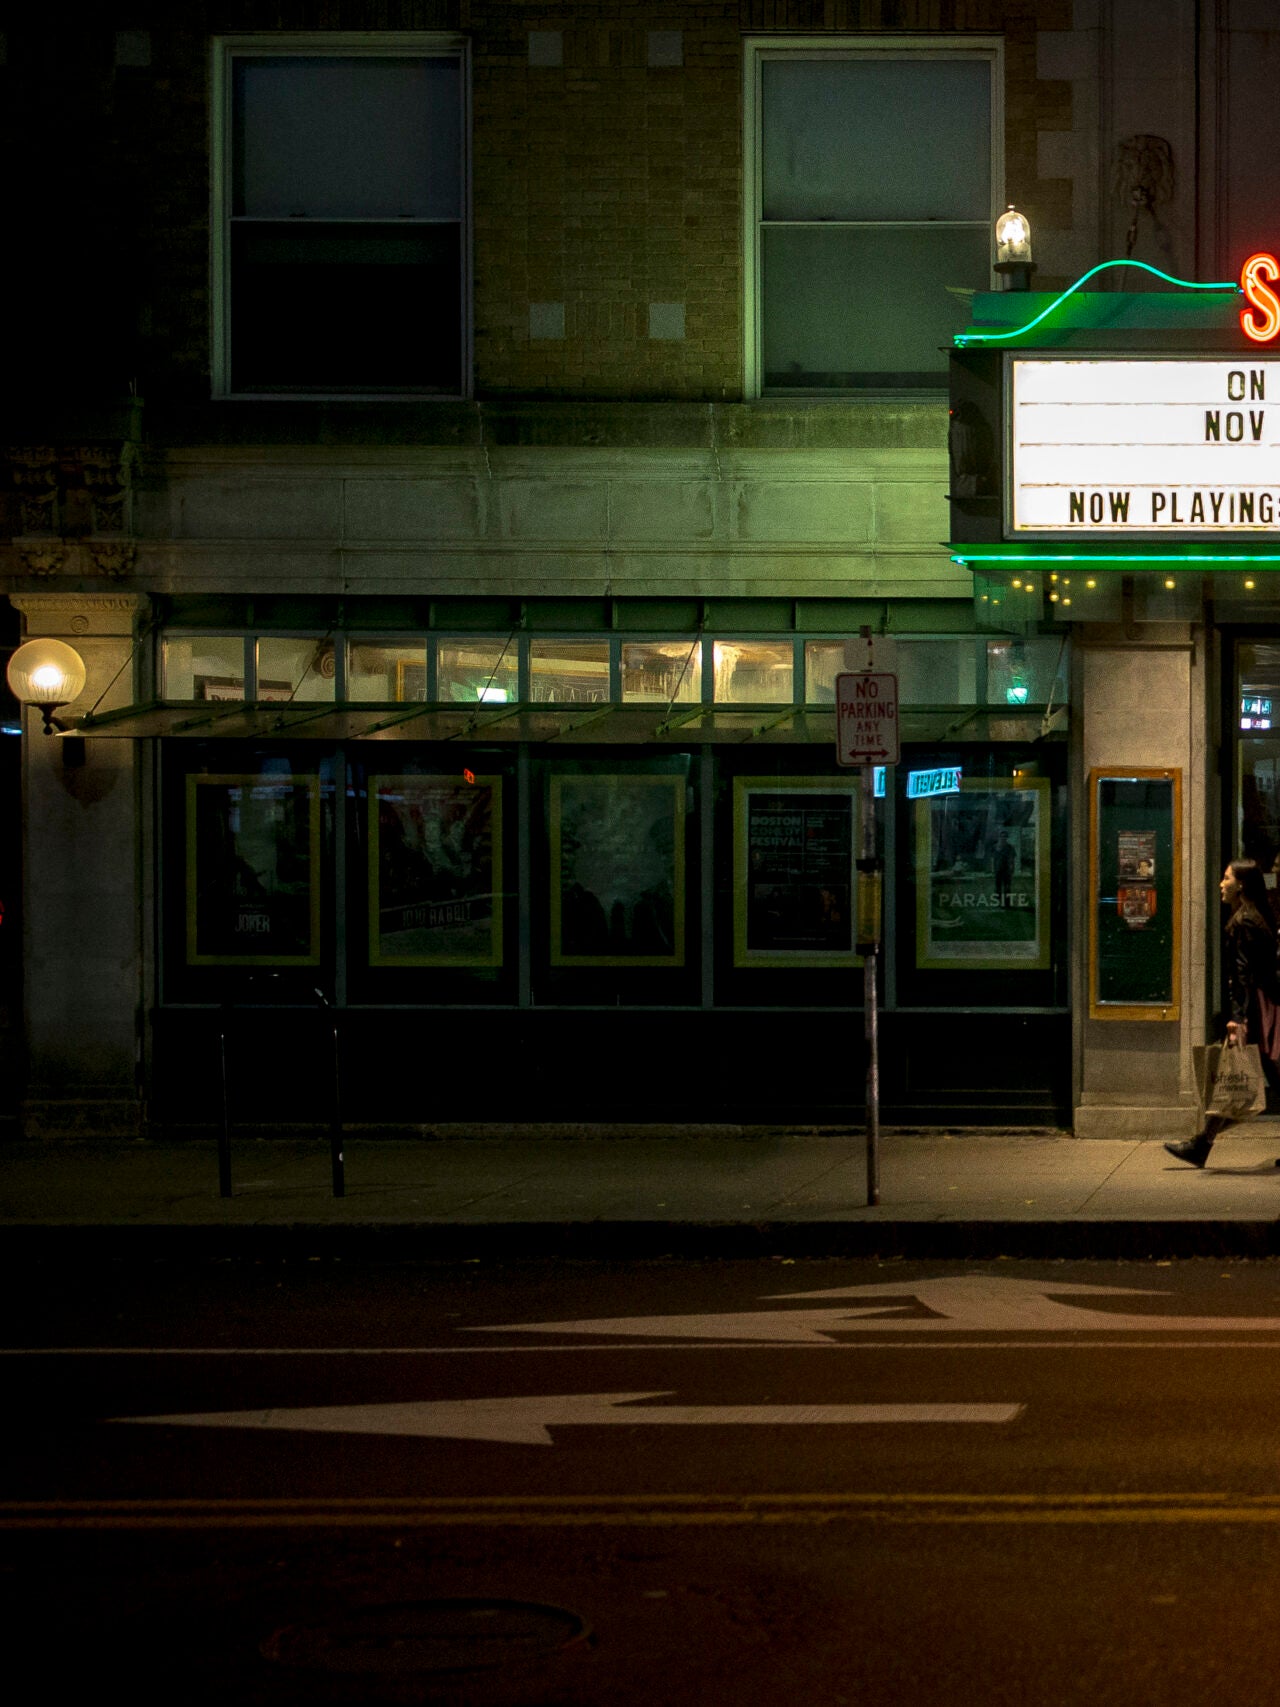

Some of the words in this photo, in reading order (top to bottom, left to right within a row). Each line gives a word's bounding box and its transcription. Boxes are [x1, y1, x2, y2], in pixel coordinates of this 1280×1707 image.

[1228, 371, 1264, 401] ON
[1205, 412, 1264, 442] NOV
[1069, 493, 1130, 523] NOW
[856, 681, 878, 698] NO
[841, 702, 894, 719] PARKING
[856, 720, 880, 733] ANY
[854, 734, 884, 746] TIME
[938, 892, 1030, 908] PARASITE
